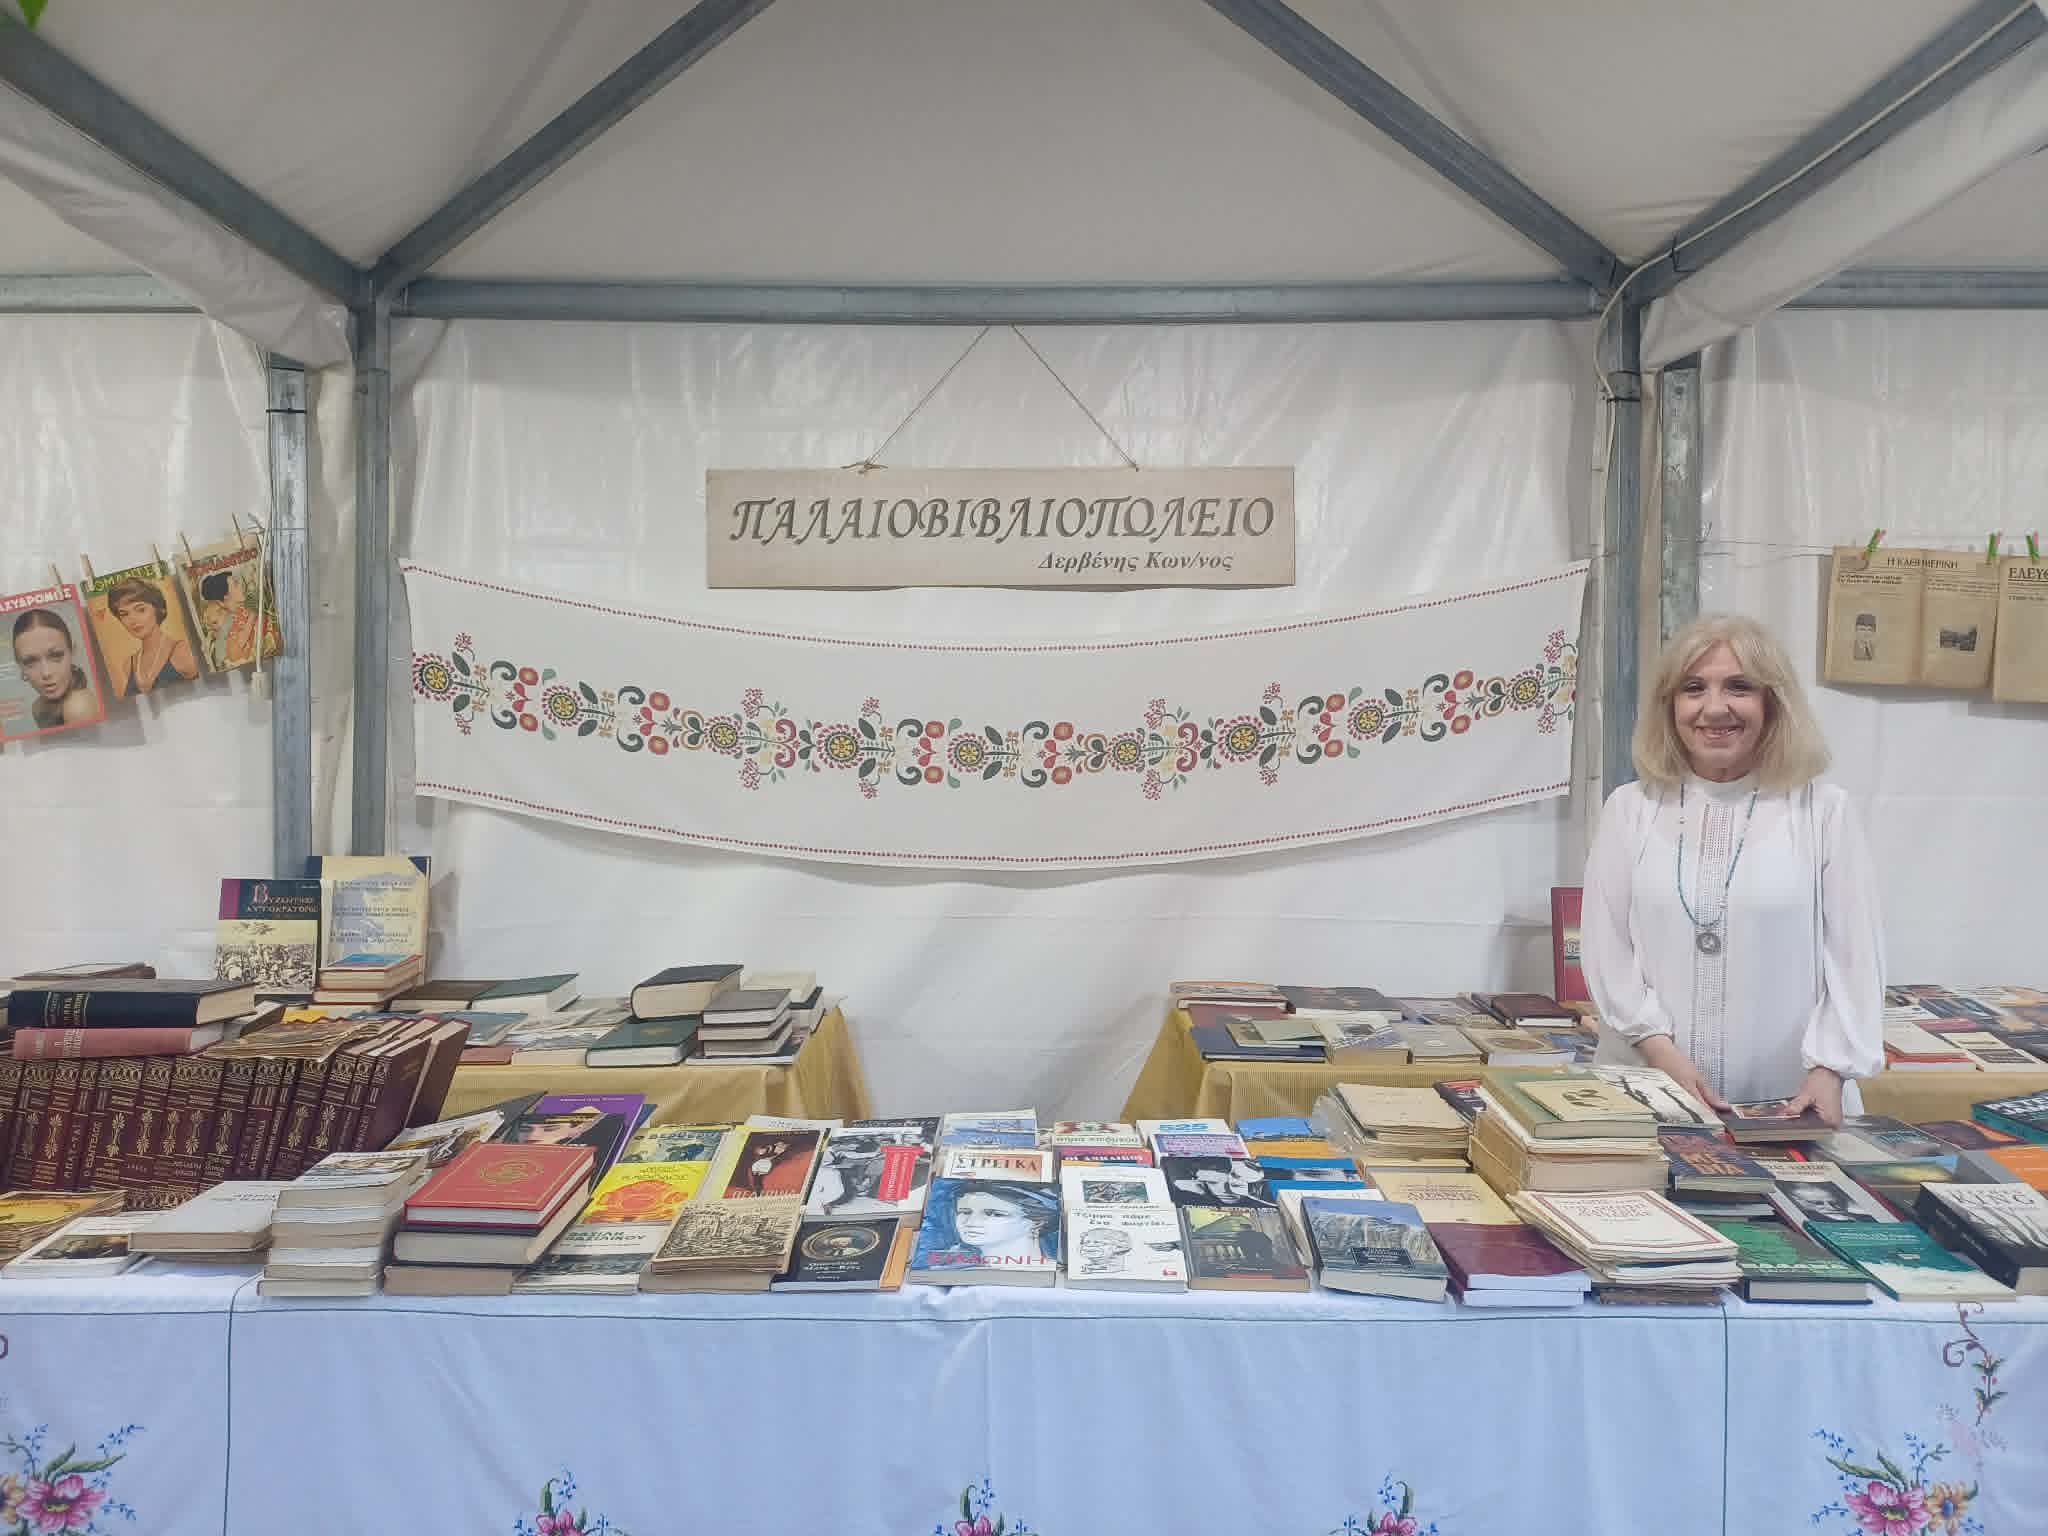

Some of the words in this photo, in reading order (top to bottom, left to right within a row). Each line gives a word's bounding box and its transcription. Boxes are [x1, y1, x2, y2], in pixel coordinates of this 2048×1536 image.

[729, 496, 1275, 544] ΠΑΛΑΙΟΒΙΒΛΙΟΠΩΛΕΙΟ
[1037, 551, 1138, 573] Δερβένης
[1143, 551, 1234, 572] Κων/νος
